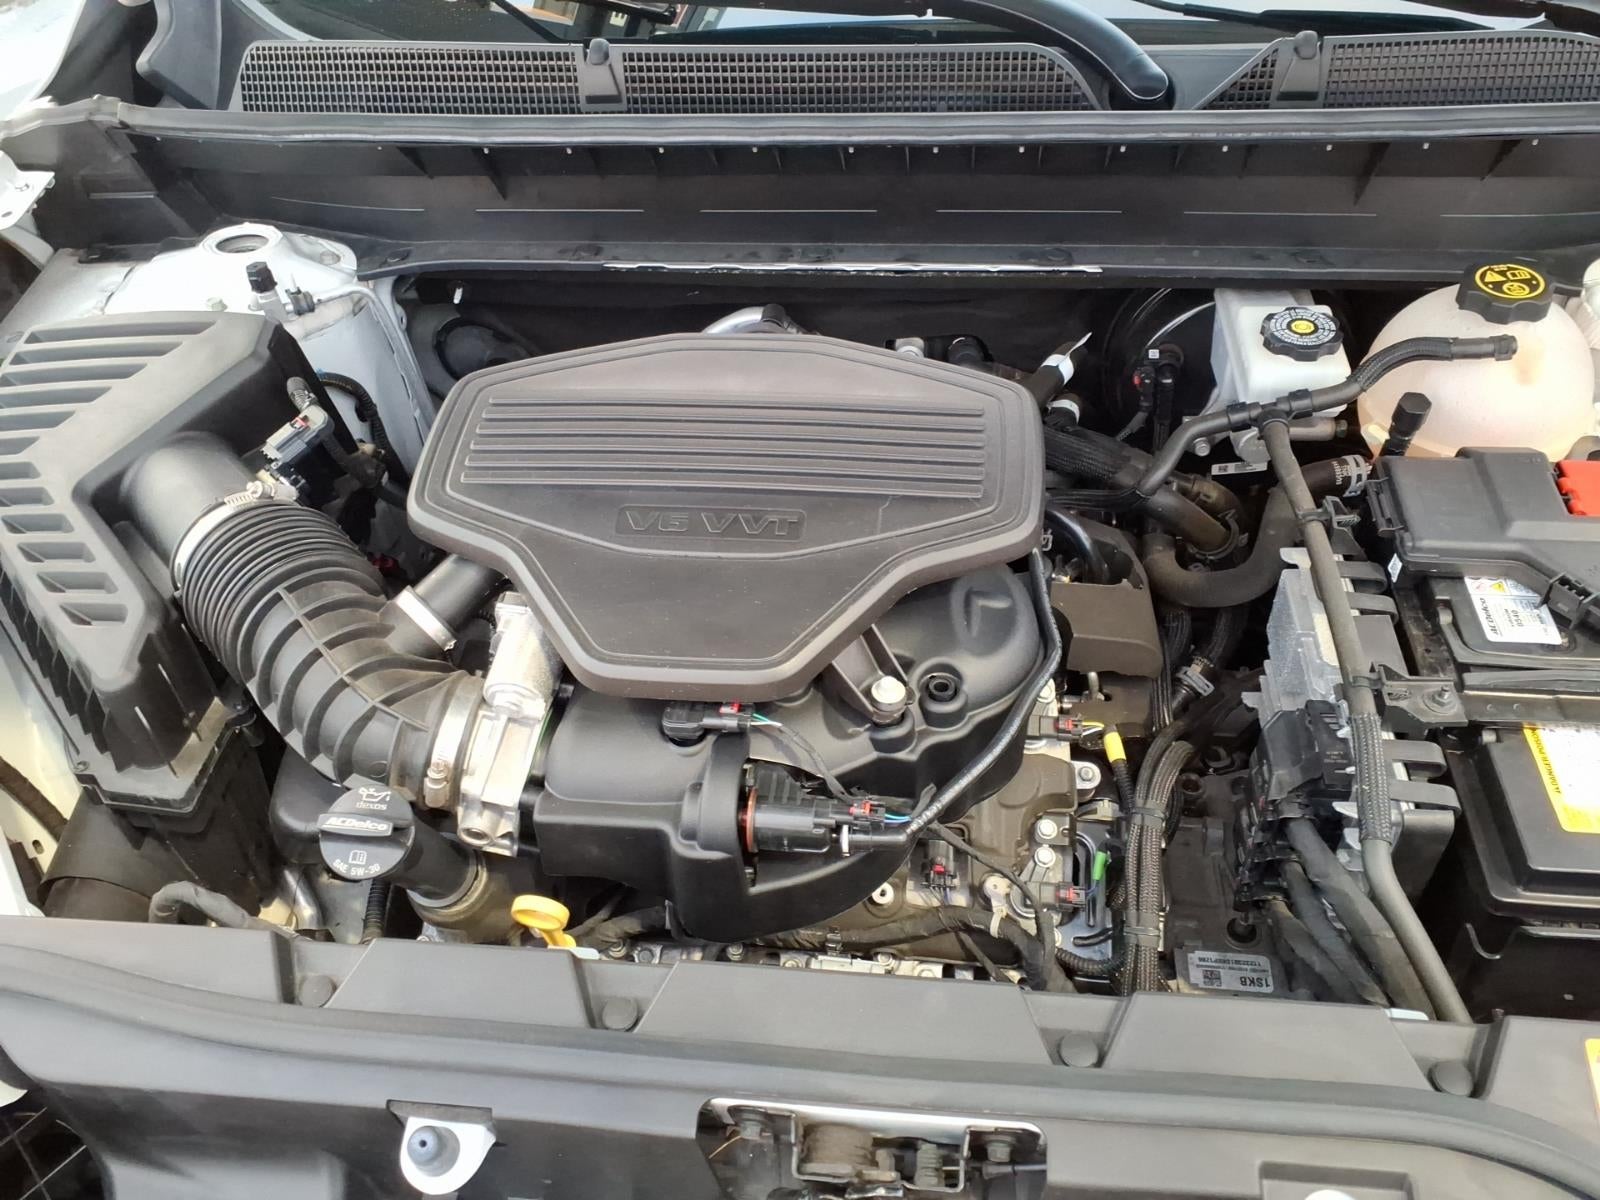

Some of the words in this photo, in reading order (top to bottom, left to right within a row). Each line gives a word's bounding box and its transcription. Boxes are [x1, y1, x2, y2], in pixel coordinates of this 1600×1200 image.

[625, 510, 689, 532] V6
[701, 512, 799, 535] VVT
[356, 801, 387, 810] dexos
[324, 817, 388, 831] ACDelco
[350, 863, 381, 877] 5W-30
[1239, 976, 1271, 988] 1SKB
